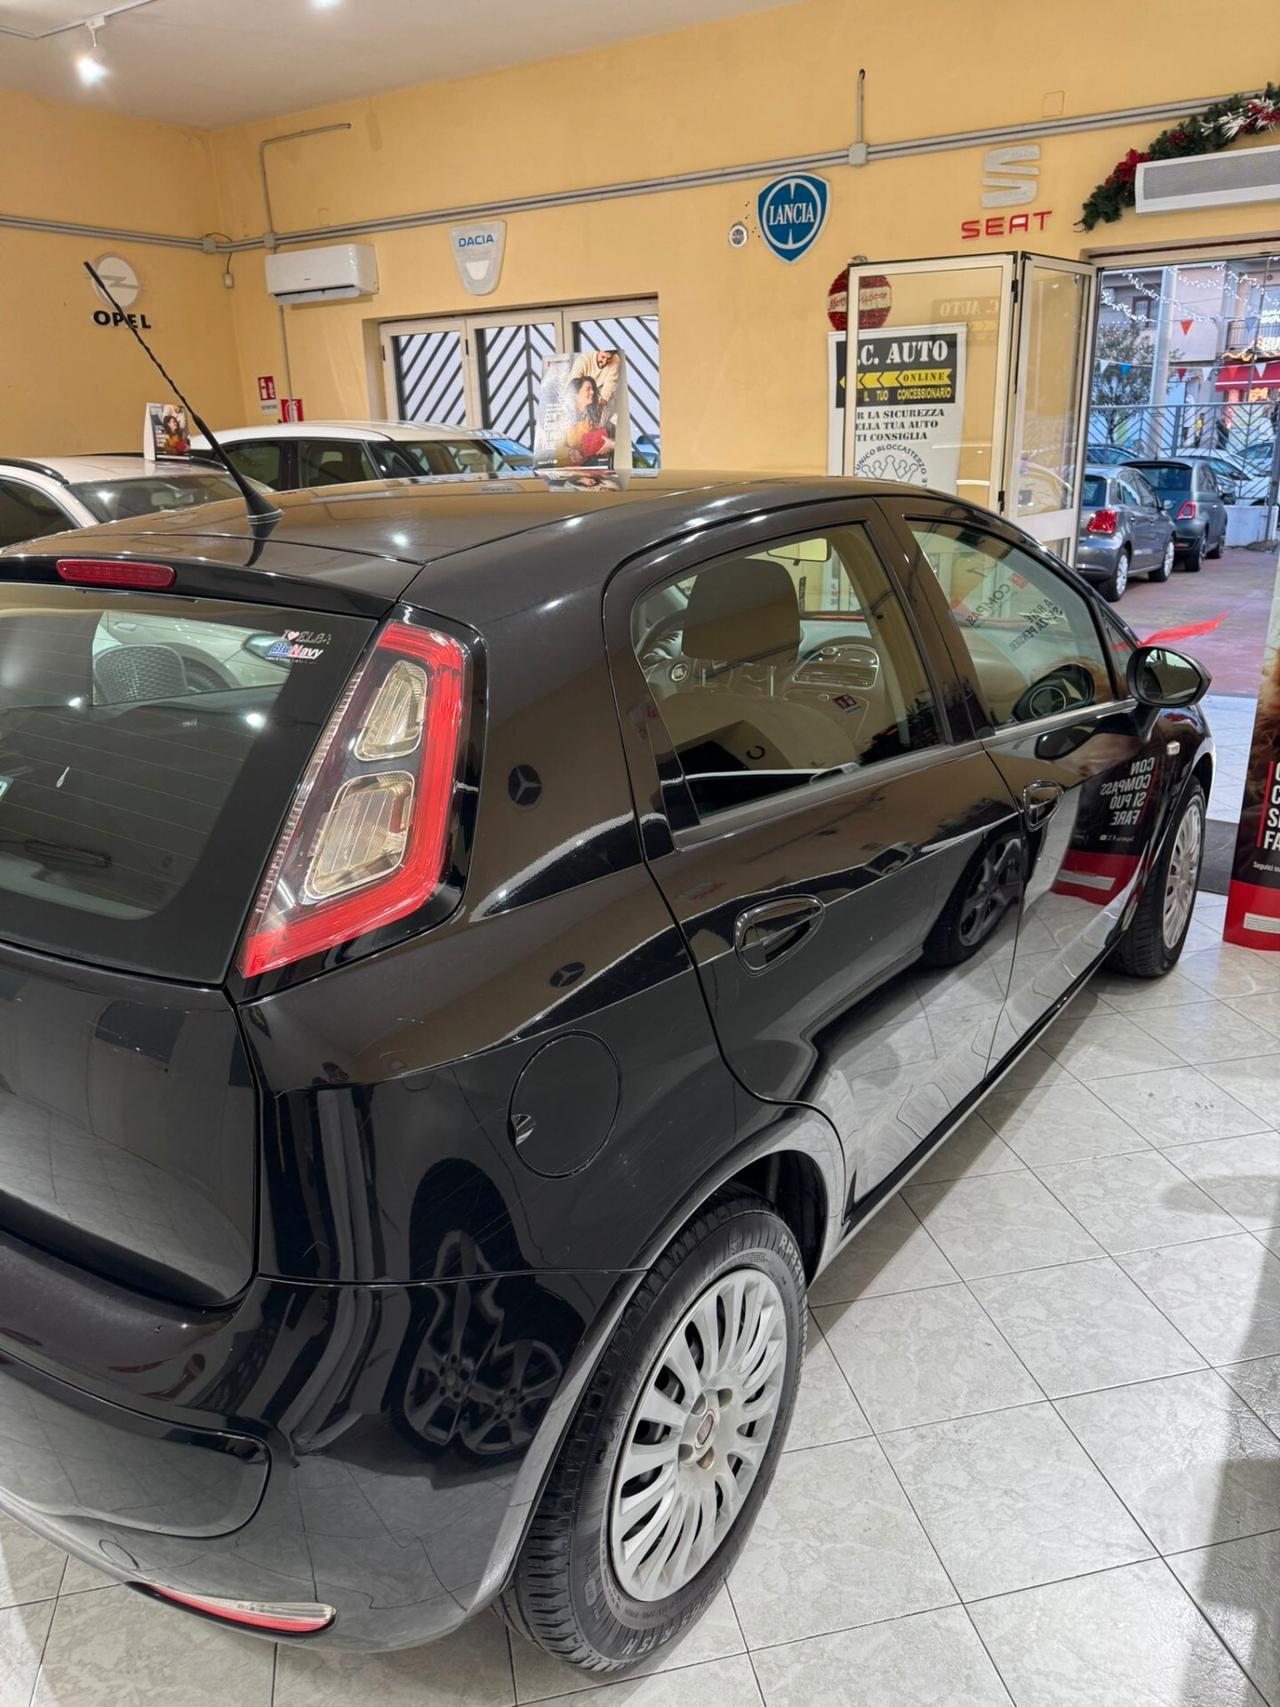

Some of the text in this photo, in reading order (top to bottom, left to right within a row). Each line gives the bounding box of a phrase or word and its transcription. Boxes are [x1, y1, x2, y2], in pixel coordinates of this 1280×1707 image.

[769, 202, 815, 226] LANCIA
[961, 210, 1053, 240] SEAT
[458, 234, 495, 248] DACIA
[93, 310, 152, 329] OPEL
[886, 339, 949, 364] AUTO
[903, 371, 945, 382] ONLINE
[876, 390, 889, 401] TUO
[897, 387, 952, 400] CONCESSIONARIO
[867, 411, 881, 420] LA
[883, 408, 945, 419] SICUREZZA
[856, 420, 938, 431] ELLA TUA AUTO
[870, 431, 928, 441] CONSIGLIA
[876, 443, 927, 475] BLOCCASTERZO
[267, 641, 323, 658] BluNavy
